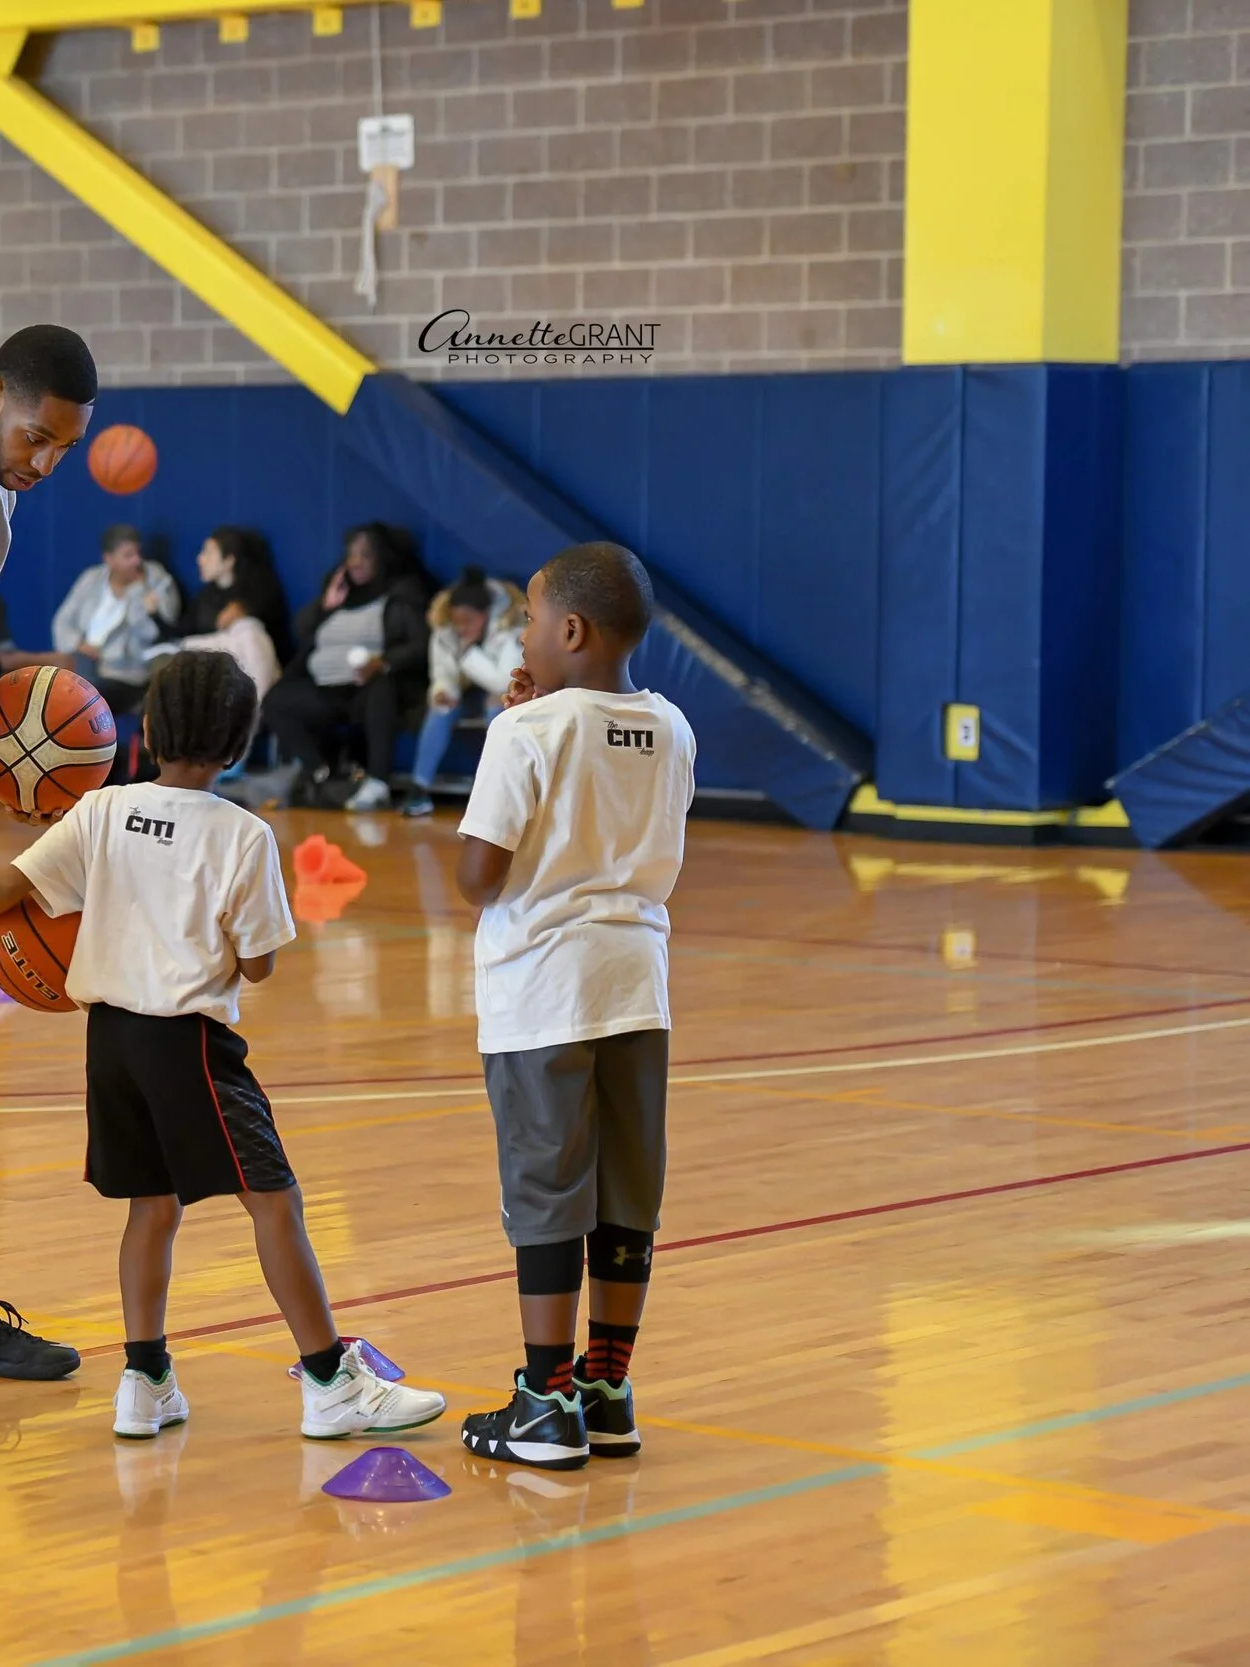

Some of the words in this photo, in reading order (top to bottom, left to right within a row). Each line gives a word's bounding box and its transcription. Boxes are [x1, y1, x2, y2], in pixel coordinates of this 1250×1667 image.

[607, 729, 653, 748] CITI
[125, 814, 176, 839] CITI
[1, 930, 62, 1001] ELITE
